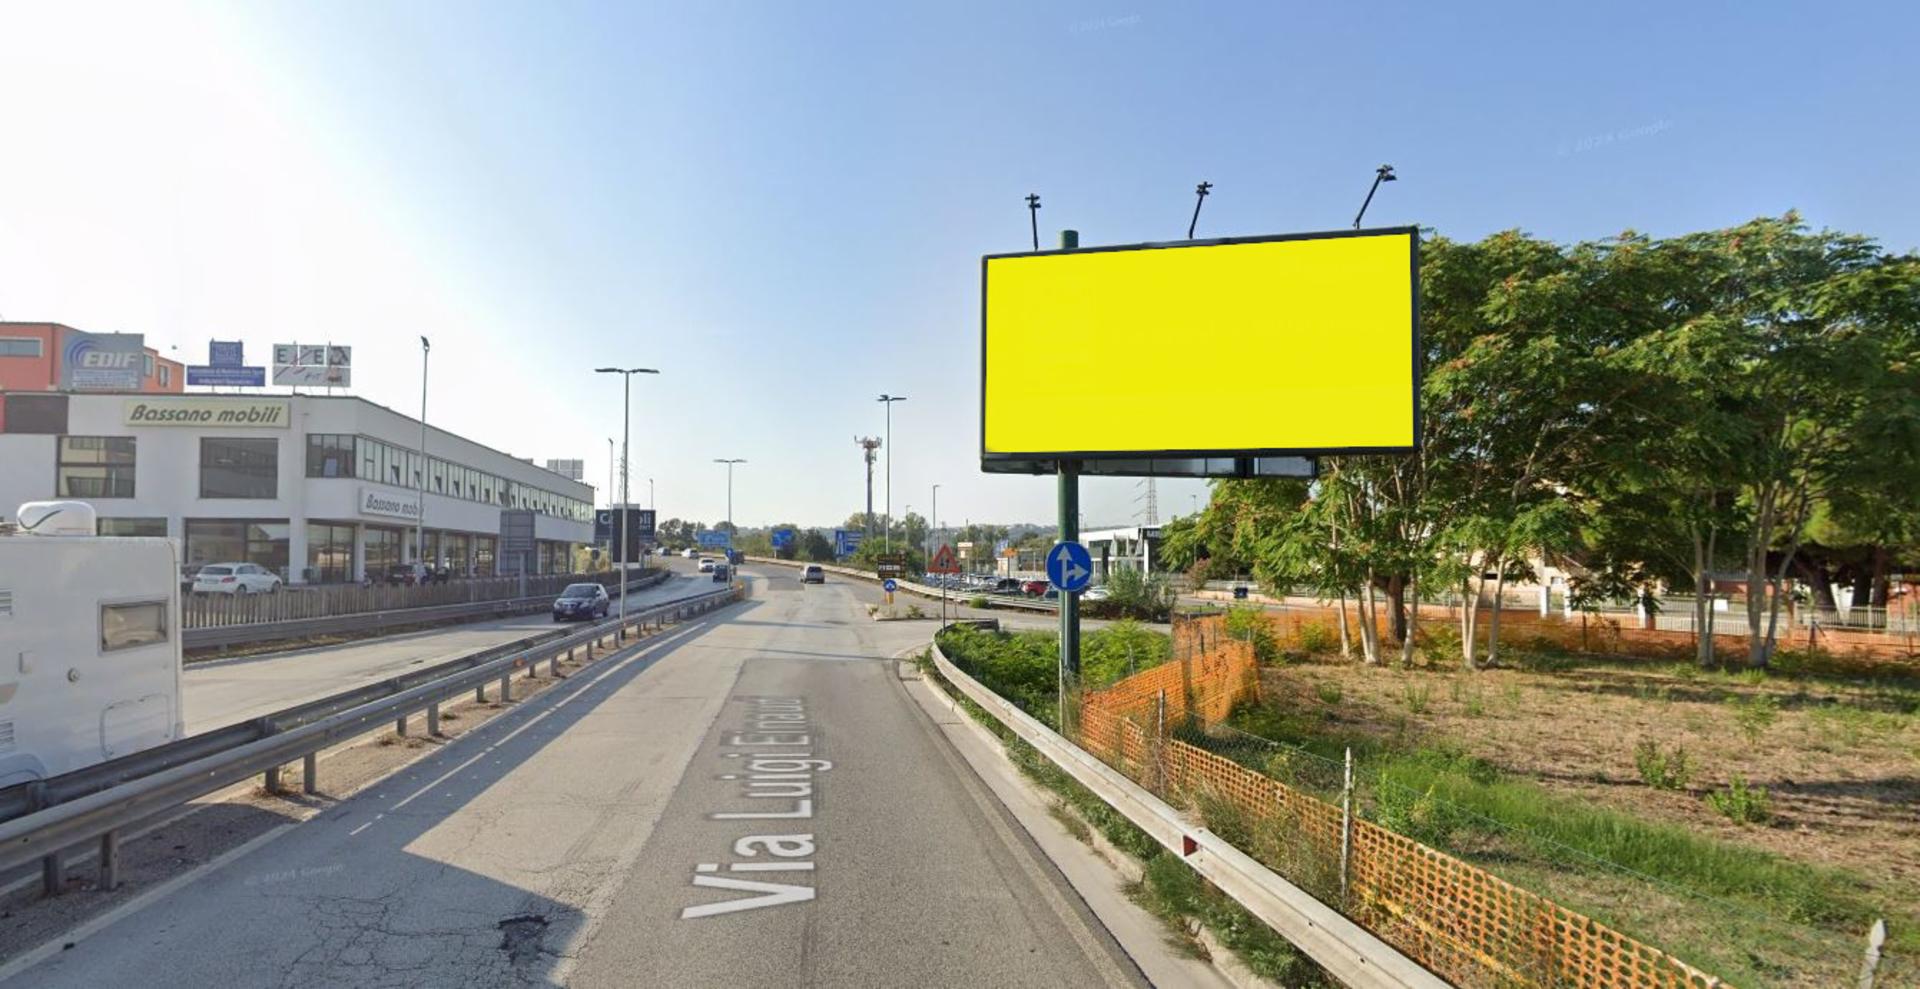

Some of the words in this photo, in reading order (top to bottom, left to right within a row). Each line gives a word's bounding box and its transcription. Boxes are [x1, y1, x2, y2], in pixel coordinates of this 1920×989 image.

[83, 351, 138, 368] EDIF
[130, 404, 213, 422] Bassano
[217, 406, 281, 424] mobili
[366, 493, 400, 513] Bassano
